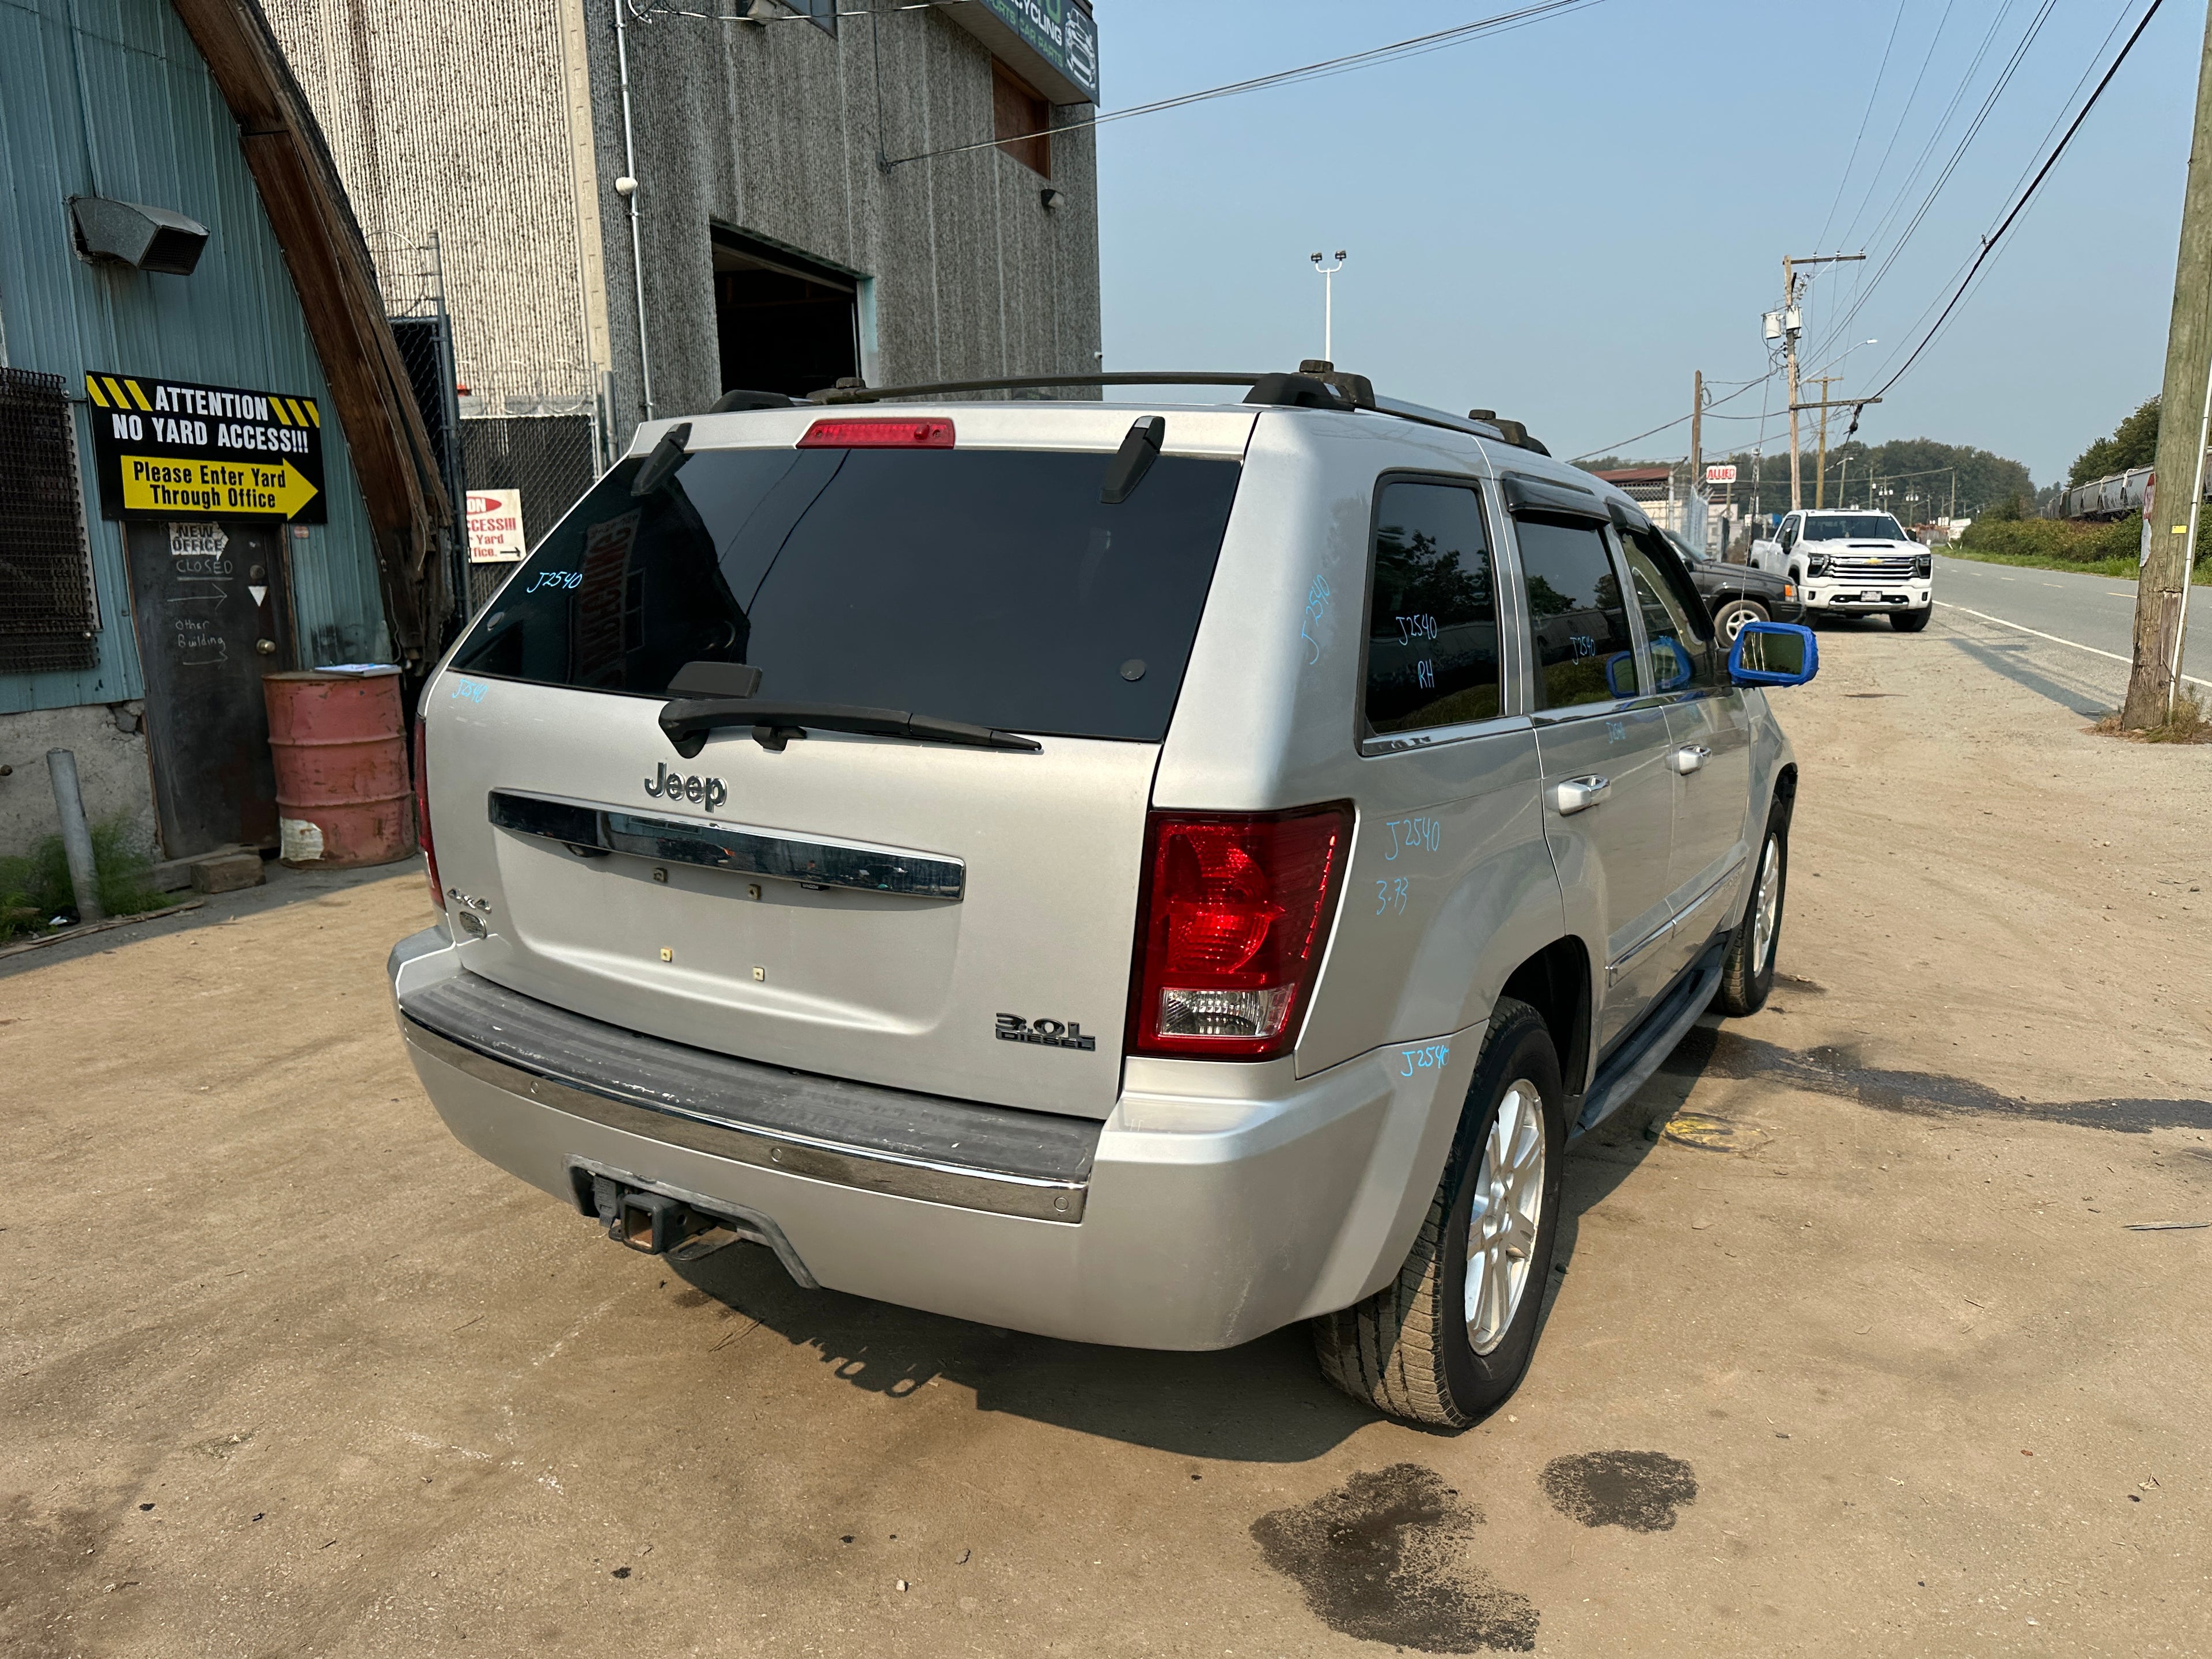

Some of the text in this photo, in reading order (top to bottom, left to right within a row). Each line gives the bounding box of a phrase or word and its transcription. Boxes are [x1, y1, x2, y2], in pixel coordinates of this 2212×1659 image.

[1038, 36, 1063, 67] PARTS
[155, 385, 268, 421] ATTENTION
[112, 413, 309, 453] NO YARD ACCESS!!!
[133, 461, 286, 488] Please Enter Yard
[150, 484, 276, 509] Through Office
[172, 538, 224, 552] OFFICE
[179, 525, 214, 538] NEW
[476, 534, 504, 545] Yard
[176, 559, 233, 574] CLOSED
[527, 571, 583, 593] J2540
[175, 619, 210, 631] Other
[1301, 574, 1330, 665] J2540
[1396, 613, 1438, 646] J2540
[177, 633, 226, 652] Building
[1570, 636, 1596, 665] J2540
[1418, 659, 1435, 689] RH
[644, 762, 728, 813] Jeep
[1385, 817, 1440, 861] J2540
[995, 1013, 1095, 1041] 3.0L
[1001, 1030, 1092, 1050] DIESEL
[1400, 1045, 1450, 1077] J2540
